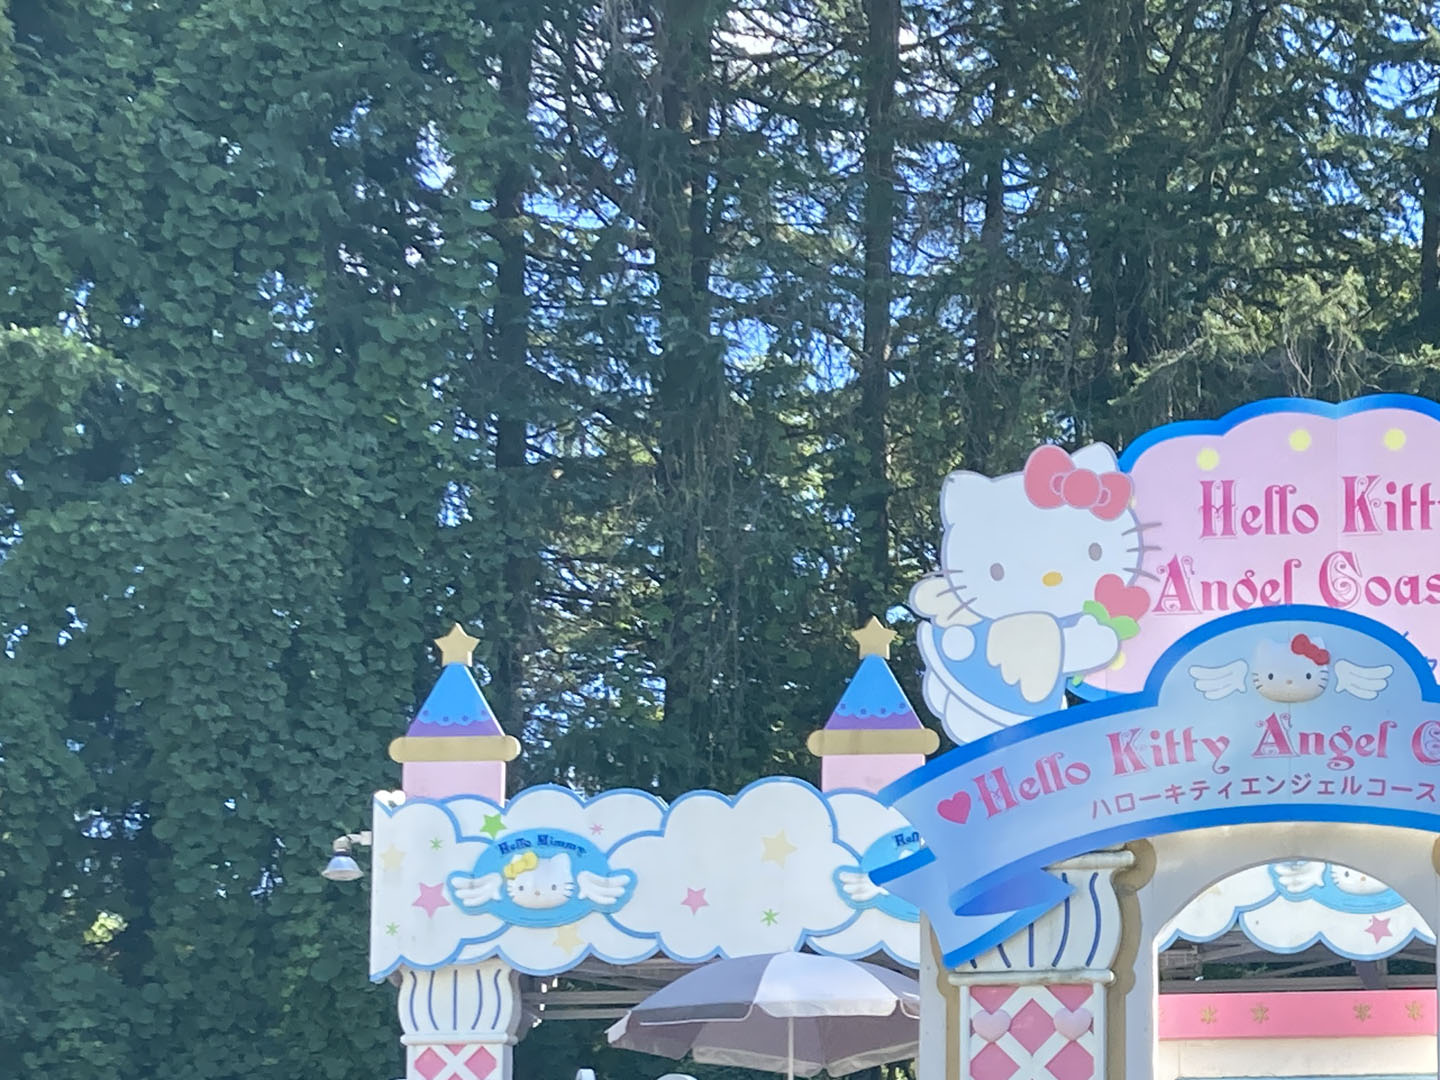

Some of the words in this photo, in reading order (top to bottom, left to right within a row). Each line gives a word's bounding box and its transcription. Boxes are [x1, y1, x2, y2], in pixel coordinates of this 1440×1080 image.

[1198, 479, 1319, 538] Hello
[972, 752, 1091, 818] Hello
[1106, 727, 1230, 774] Kitty
[1252, 712, 1397, 771] Angel
